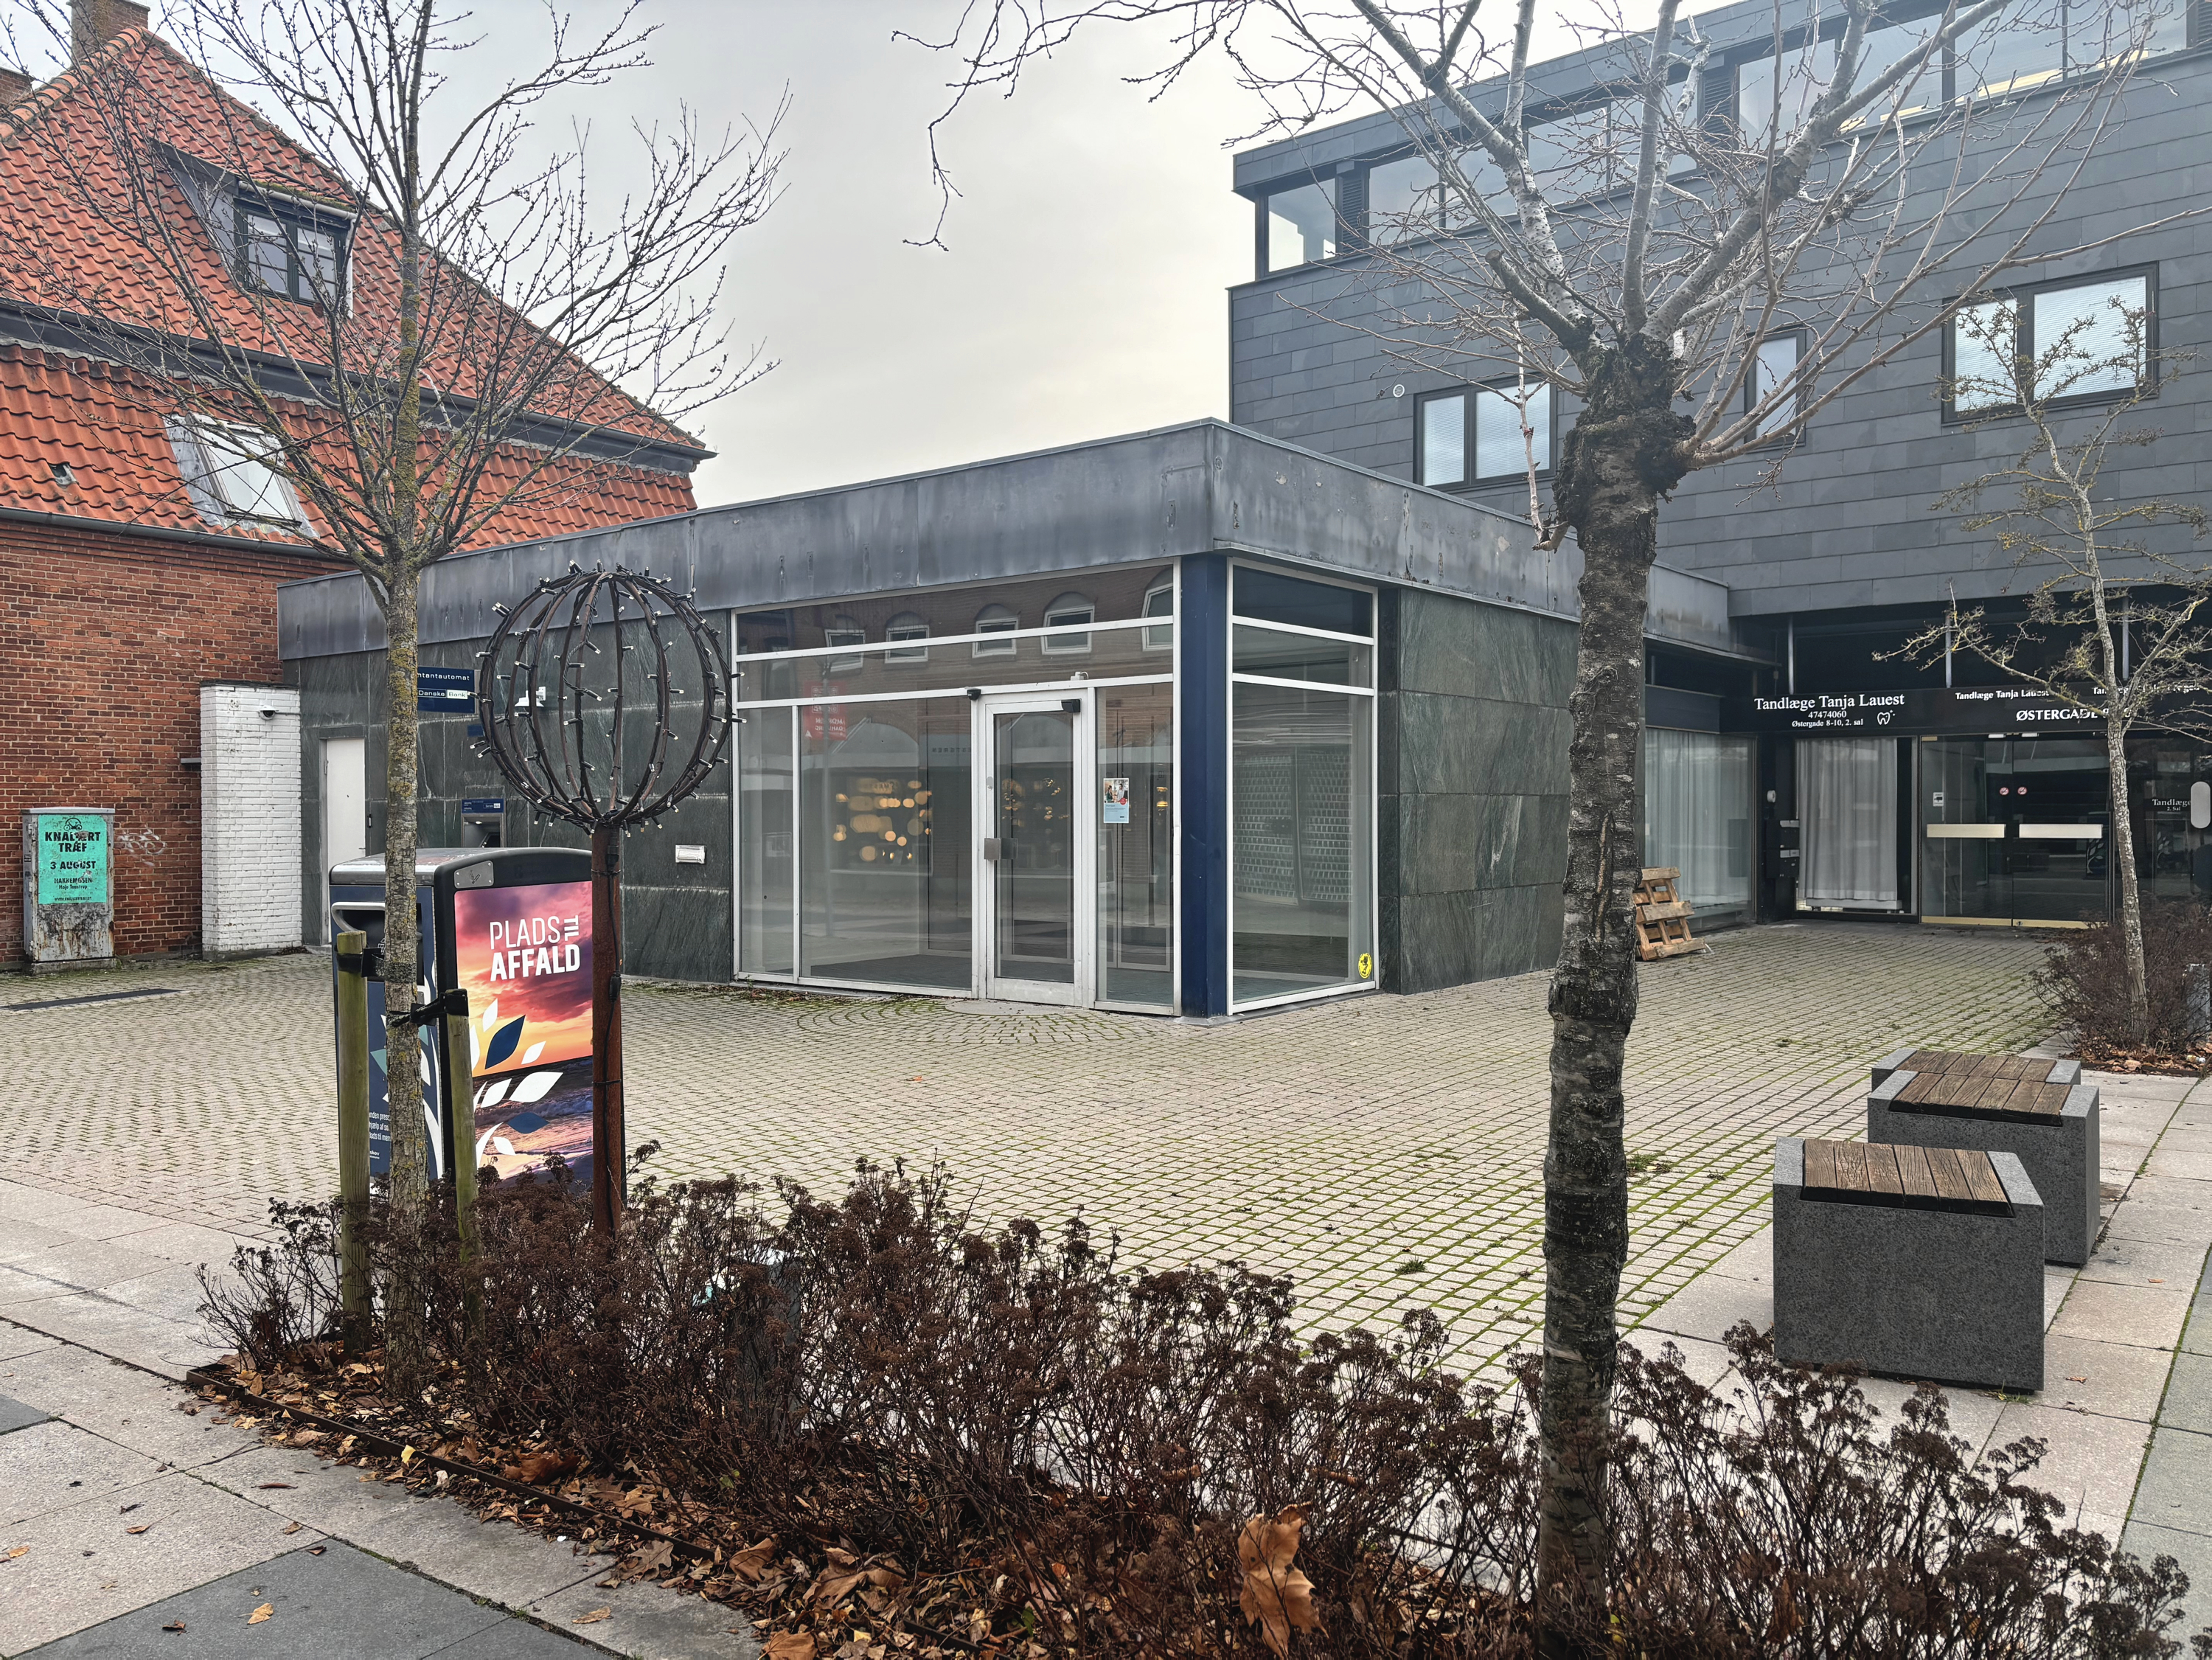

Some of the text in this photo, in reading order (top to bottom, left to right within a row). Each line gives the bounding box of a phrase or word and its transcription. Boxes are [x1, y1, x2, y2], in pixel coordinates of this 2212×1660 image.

[417, 673, 470, 681] ntantautomat
[1955, 691, 1994, 701] Tandlæge
[1995, 690, 2019, 700] Tanja
[1754, 694, 1905, 711] Tandlæge Tanja Lauest
[1808, 710, 1847, 718] 47474060
[1792, 720, 1824, 729] Østergade
[50, 861, 96, 869] 3 AUGUST
[490, 914, 579, 950] PLADS TIL
[490, 944, 580, 982] AFFALD
